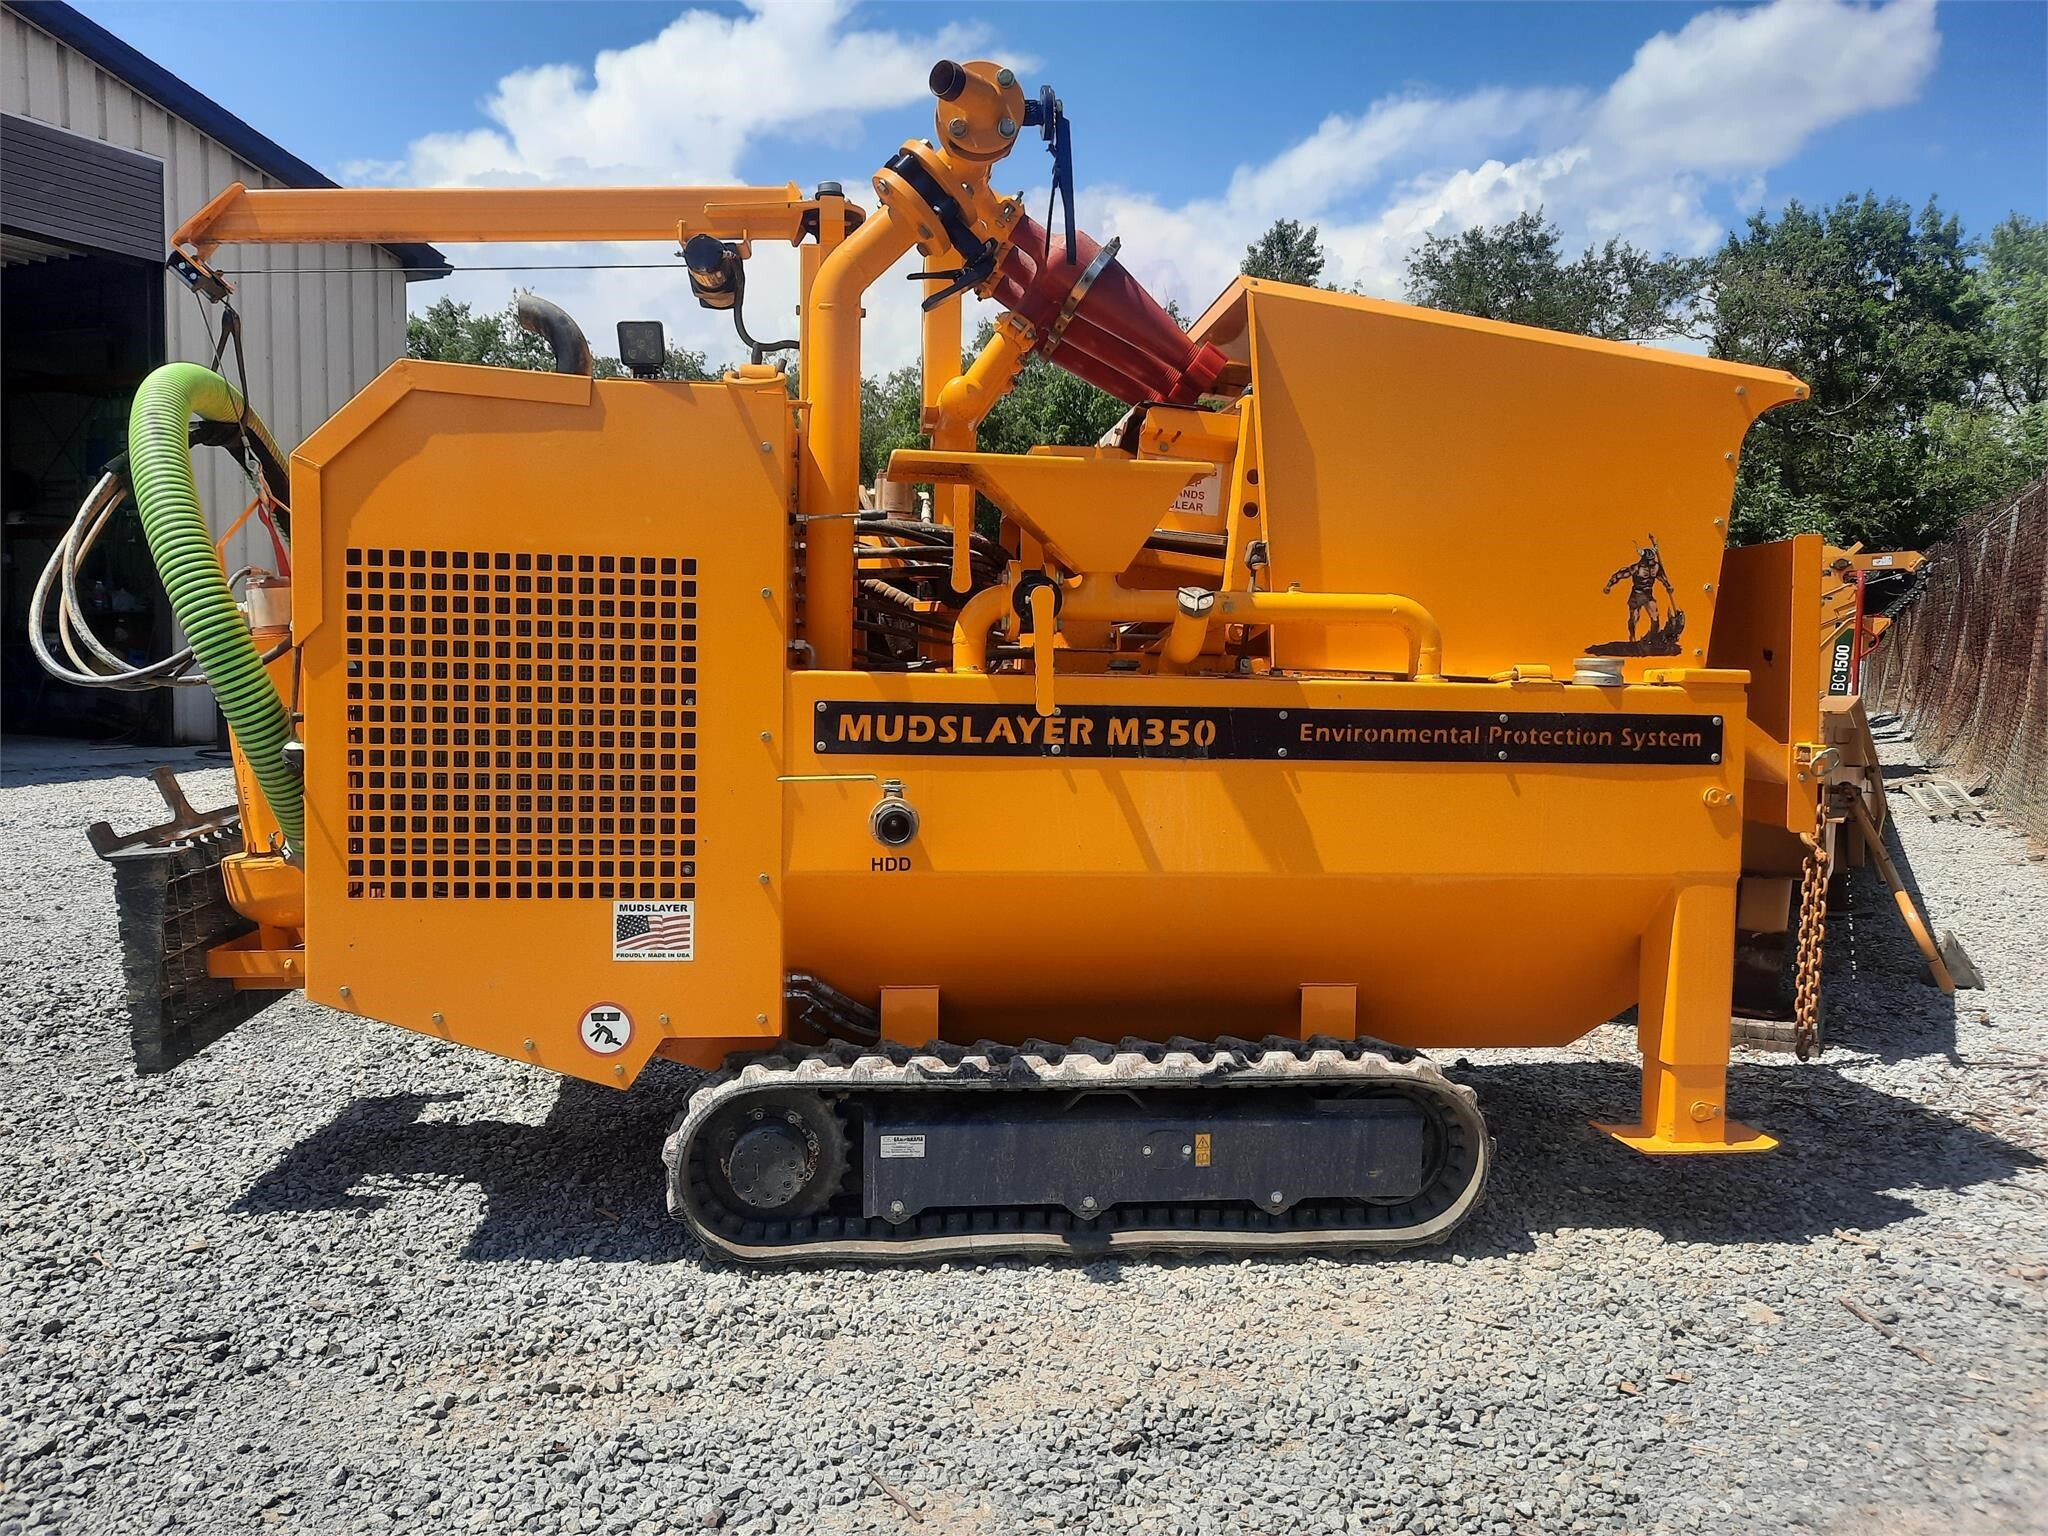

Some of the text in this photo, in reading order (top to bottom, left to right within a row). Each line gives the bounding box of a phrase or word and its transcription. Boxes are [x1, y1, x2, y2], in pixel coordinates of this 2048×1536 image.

[838, 714, 1216, 748] MUDSLAYER M350
[1299, 723, 1702, 751] Environmental Protection System
[871, 857, 912, 871] HDD
[619, 904, 688, 912] MUDSLAYER
